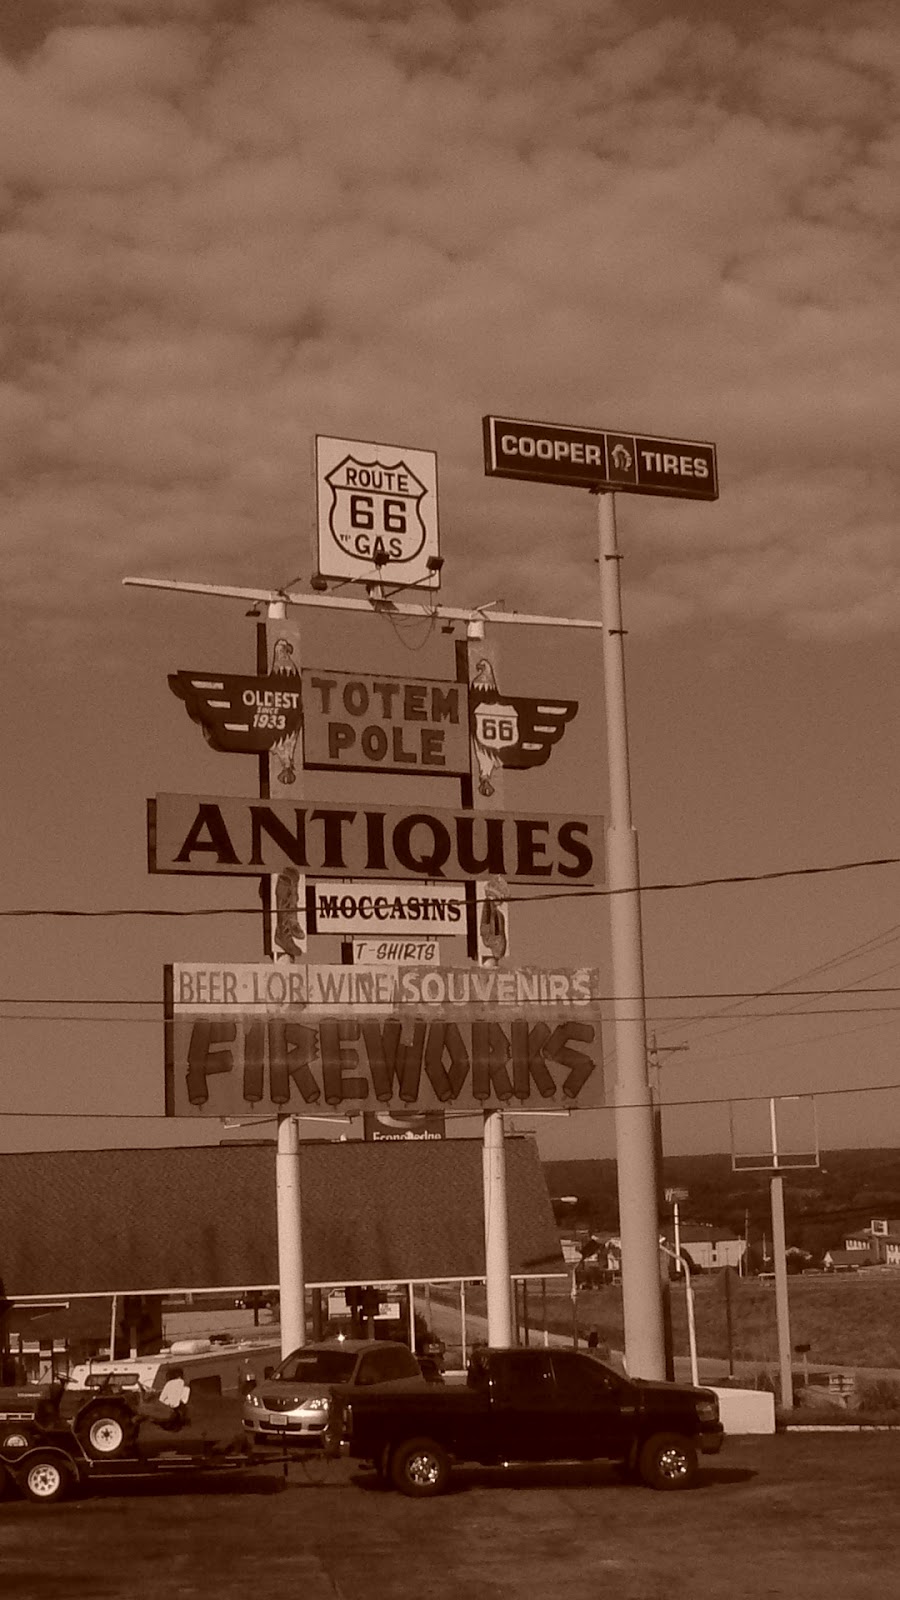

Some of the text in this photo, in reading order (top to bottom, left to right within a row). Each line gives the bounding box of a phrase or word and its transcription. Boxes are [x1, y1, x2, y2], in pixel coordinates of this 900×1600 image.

[501, 435, 709, 478] COOPER TIRES
[346, 467, 409, 493] ROUTE
[350, 494, 407, 534] 66
[354, 533, 403, 558] GAS
[242, 689, 300, 710] OLDEST
[311, 677, 460, 725] TOTEM
[252, 713, 287, 730] 1933
[482, 719, 514, 742] 66
[327, 722, 447, 766] POLE
[172, 803, 595, 878] ANTIQUES
[319, 895, 462, 922] MOCCASINS
[356, 942, 436, 961] T-SHIRTS
[179, 971, 238, 1003] BEER
[401, 967, 592, 1007] SOUVENIRS
[186, 1017, 597, 1106] FIREWORKS
